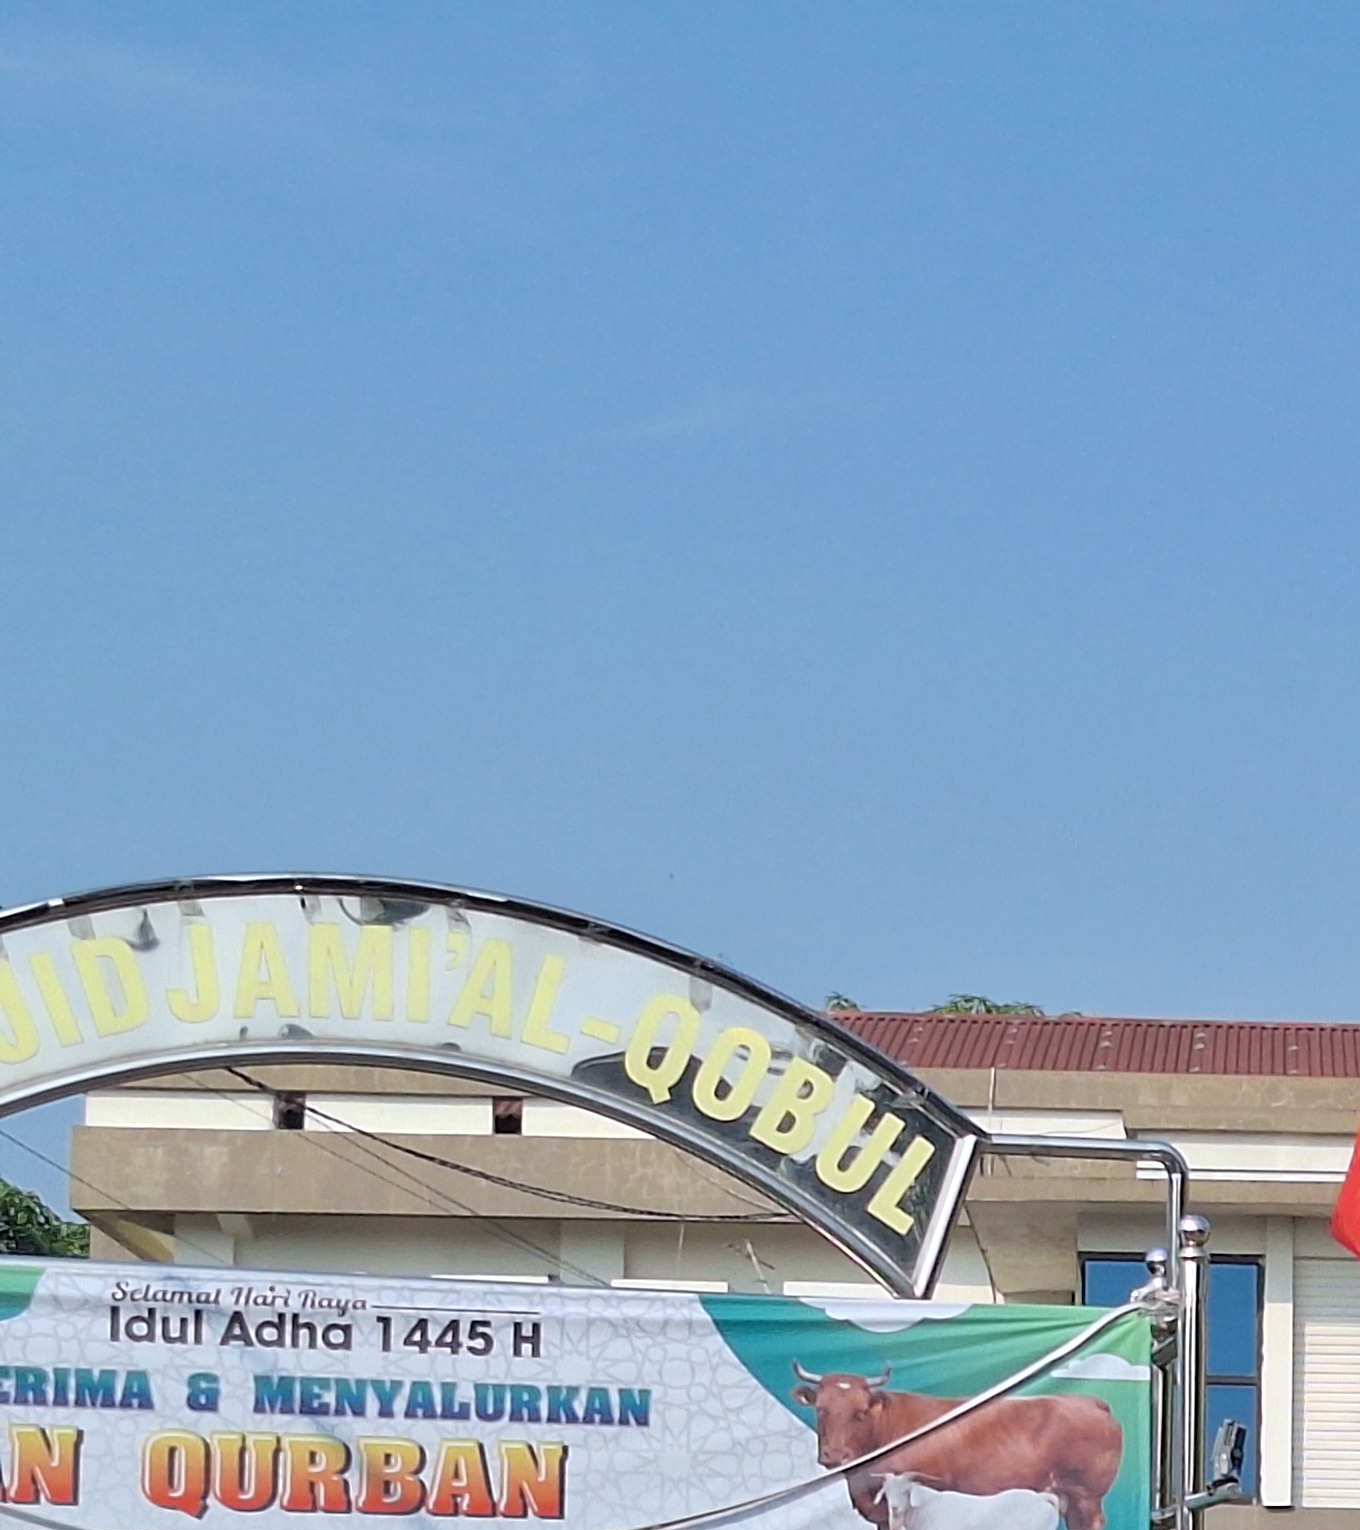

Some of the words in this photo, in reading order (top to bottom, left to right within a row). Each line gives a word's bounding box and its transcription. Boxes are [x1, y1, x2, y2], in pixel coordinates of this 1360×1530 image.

[109, 1305, 204, 1347] Idul
[219, 1310, 353, 1351] Adha
[375, 1315, 496, 1357] 1445
[512, 1321, 542, 1358] H
[186, 1371, 221, 1414] &
[253, 1375, 653, 1428] MENYALURKAN
[0, 1422, 84, 1506] N
[141, 1428, 570, 1519] QURBAN
